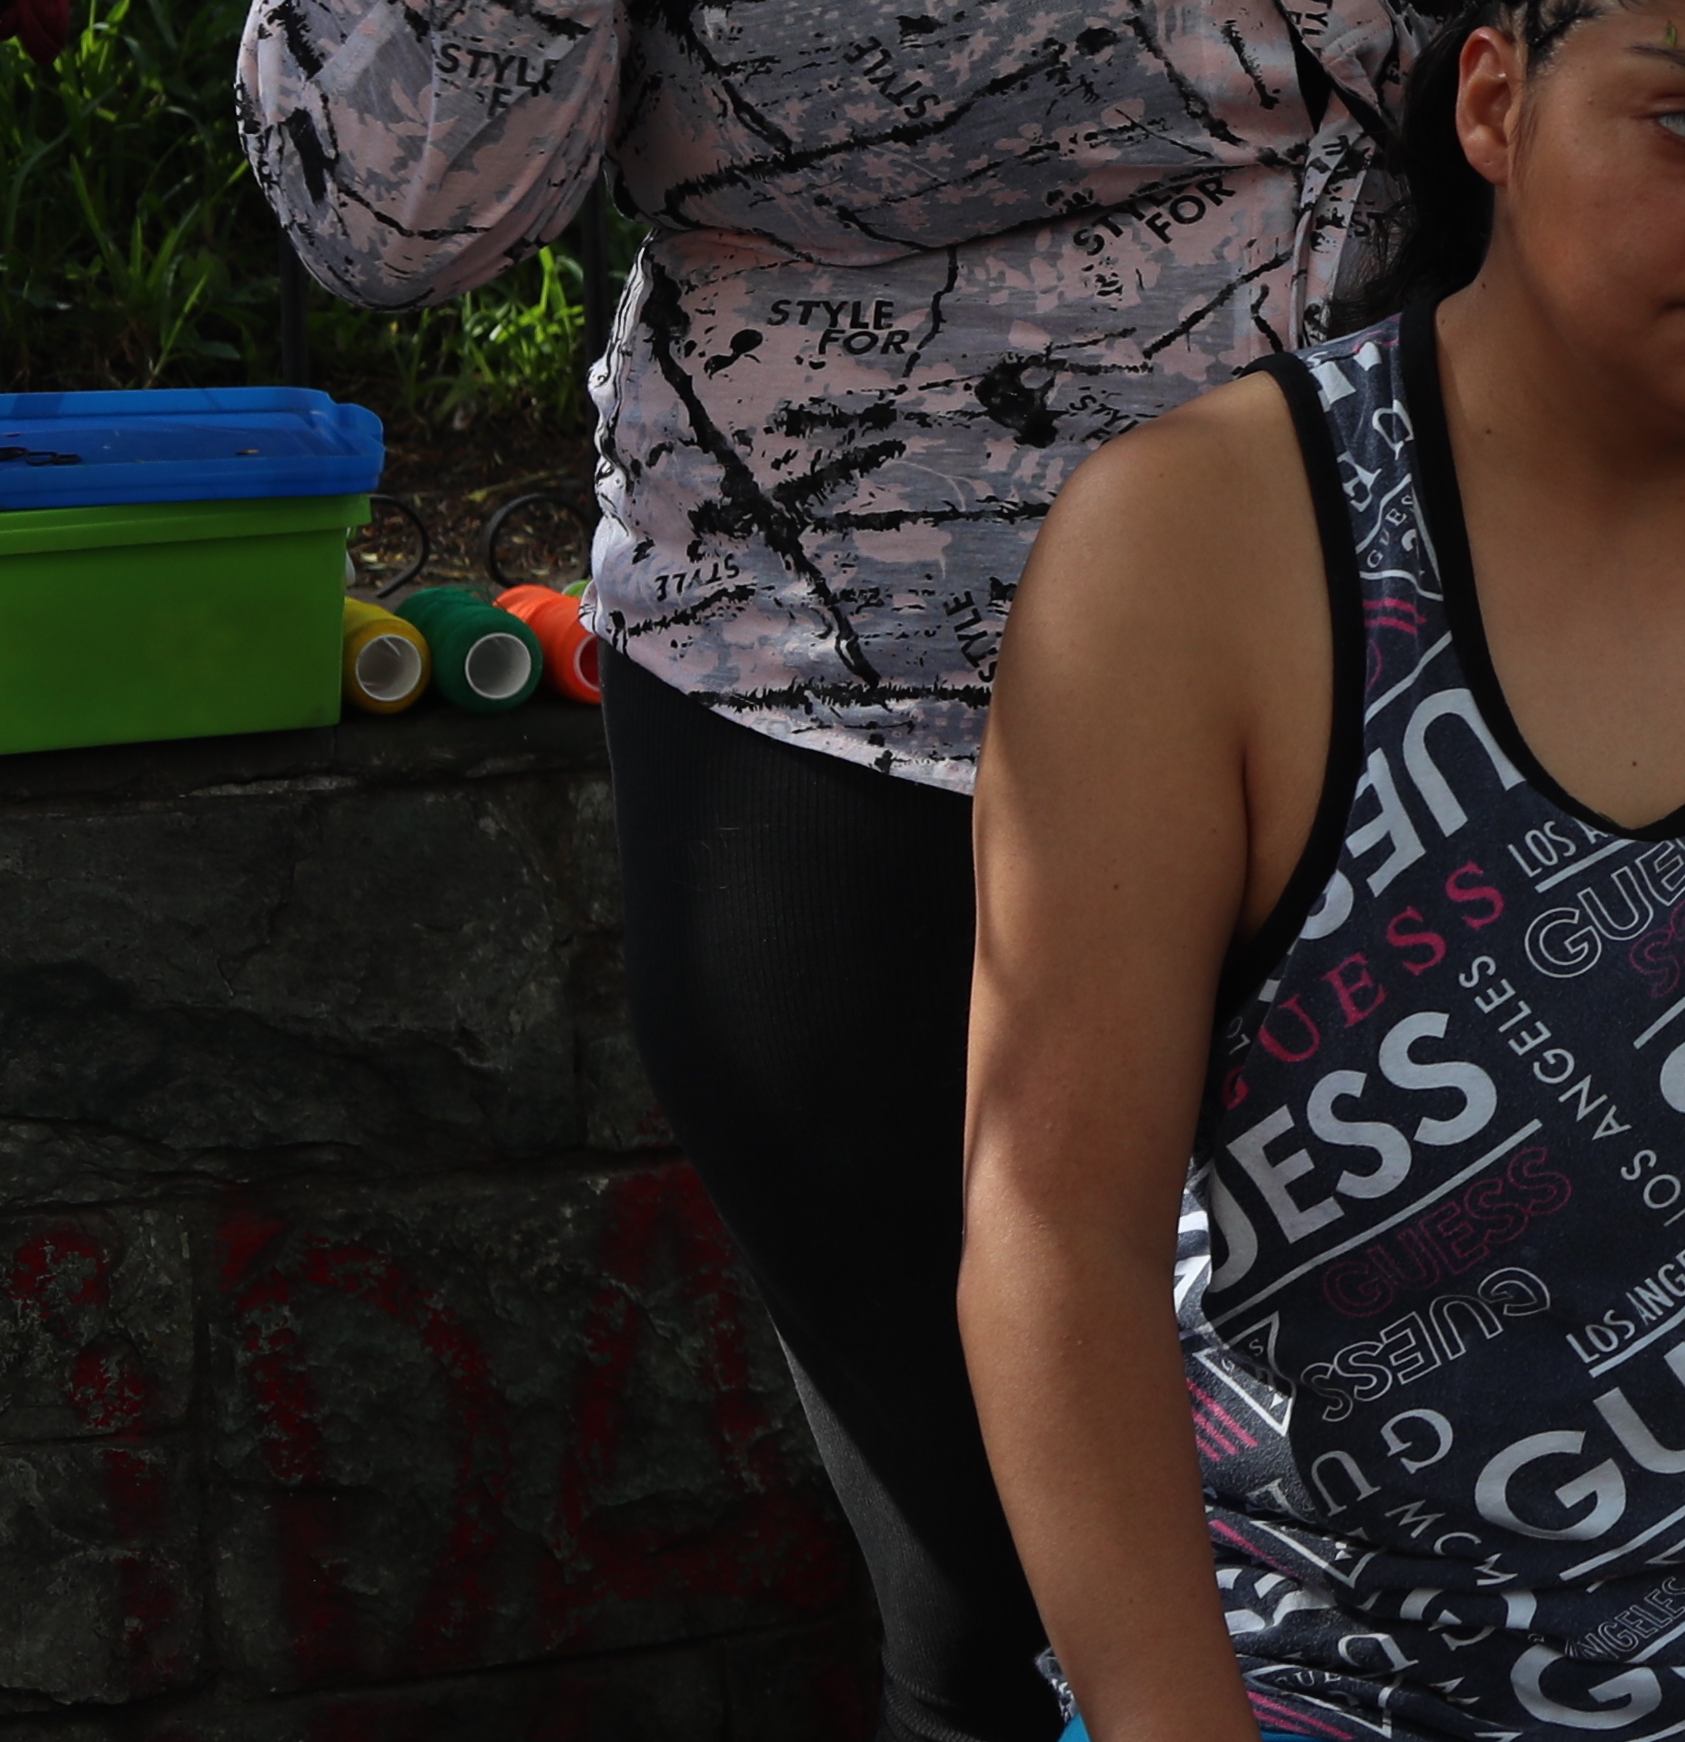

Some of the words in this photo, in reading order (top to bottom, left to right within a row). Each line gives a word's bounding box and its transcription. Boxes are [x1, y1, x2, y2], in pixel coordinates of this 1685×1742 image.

[848, 36, 942, 120] STYLE
[1145, 176, 1236, 244] FOR
[767, 299, 895, 328] STYLE
[818, 328, 910, 357] FOR
[654, 557, 742, 602] STYLE
[942, 590, 1001, 685] STYLE
[1459, 954, 1633, 1141] ANGELES
[1321, 1146, 1573, 1318] GUESS
[1300, 1266, 1551, 1423] GUESS
[1565, 1309, 1636, 1366] LOS
